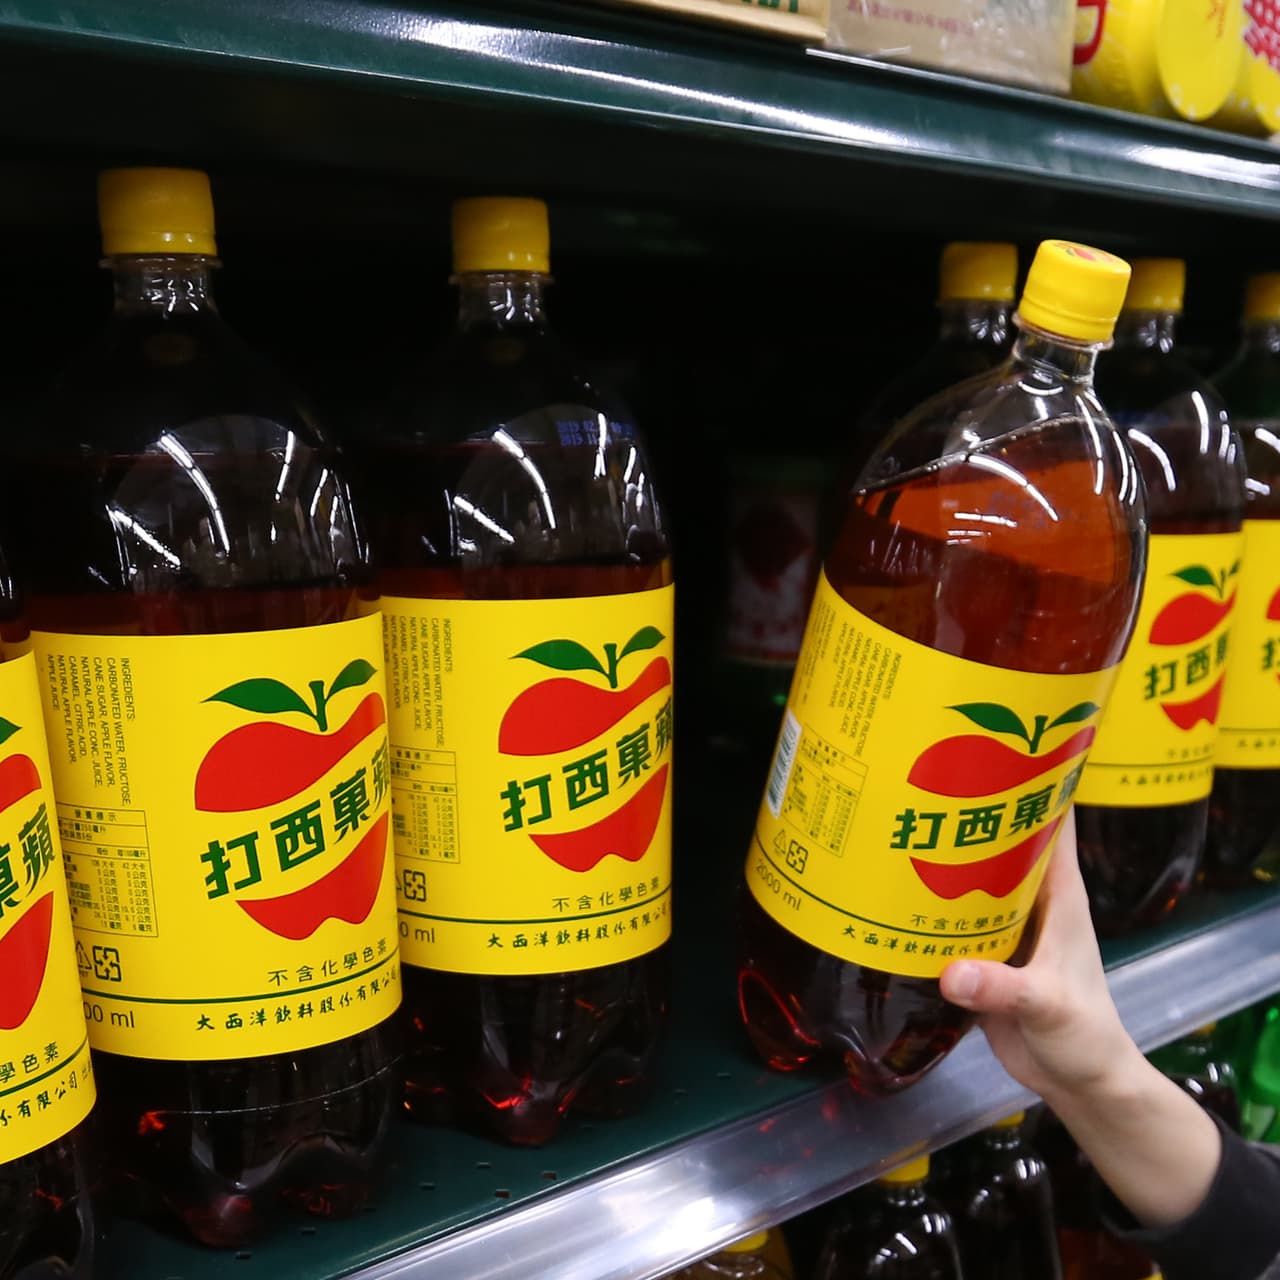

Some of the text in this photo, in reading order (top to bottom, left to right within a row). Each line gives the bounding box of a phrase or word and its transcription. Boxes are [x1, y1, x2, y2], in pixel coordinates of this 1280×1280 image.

[94, 657, 103, 682] CANE
[101, 720, 111, 749] APPLE
[107, 658, 121, 719] CARBONATED
[86, 699, 96, 727] APPLE
[414, 927, 436, 943] ml
[267, 937, 387, 987] 不含化學色素
[108, 1009, 135, 1030] ml
